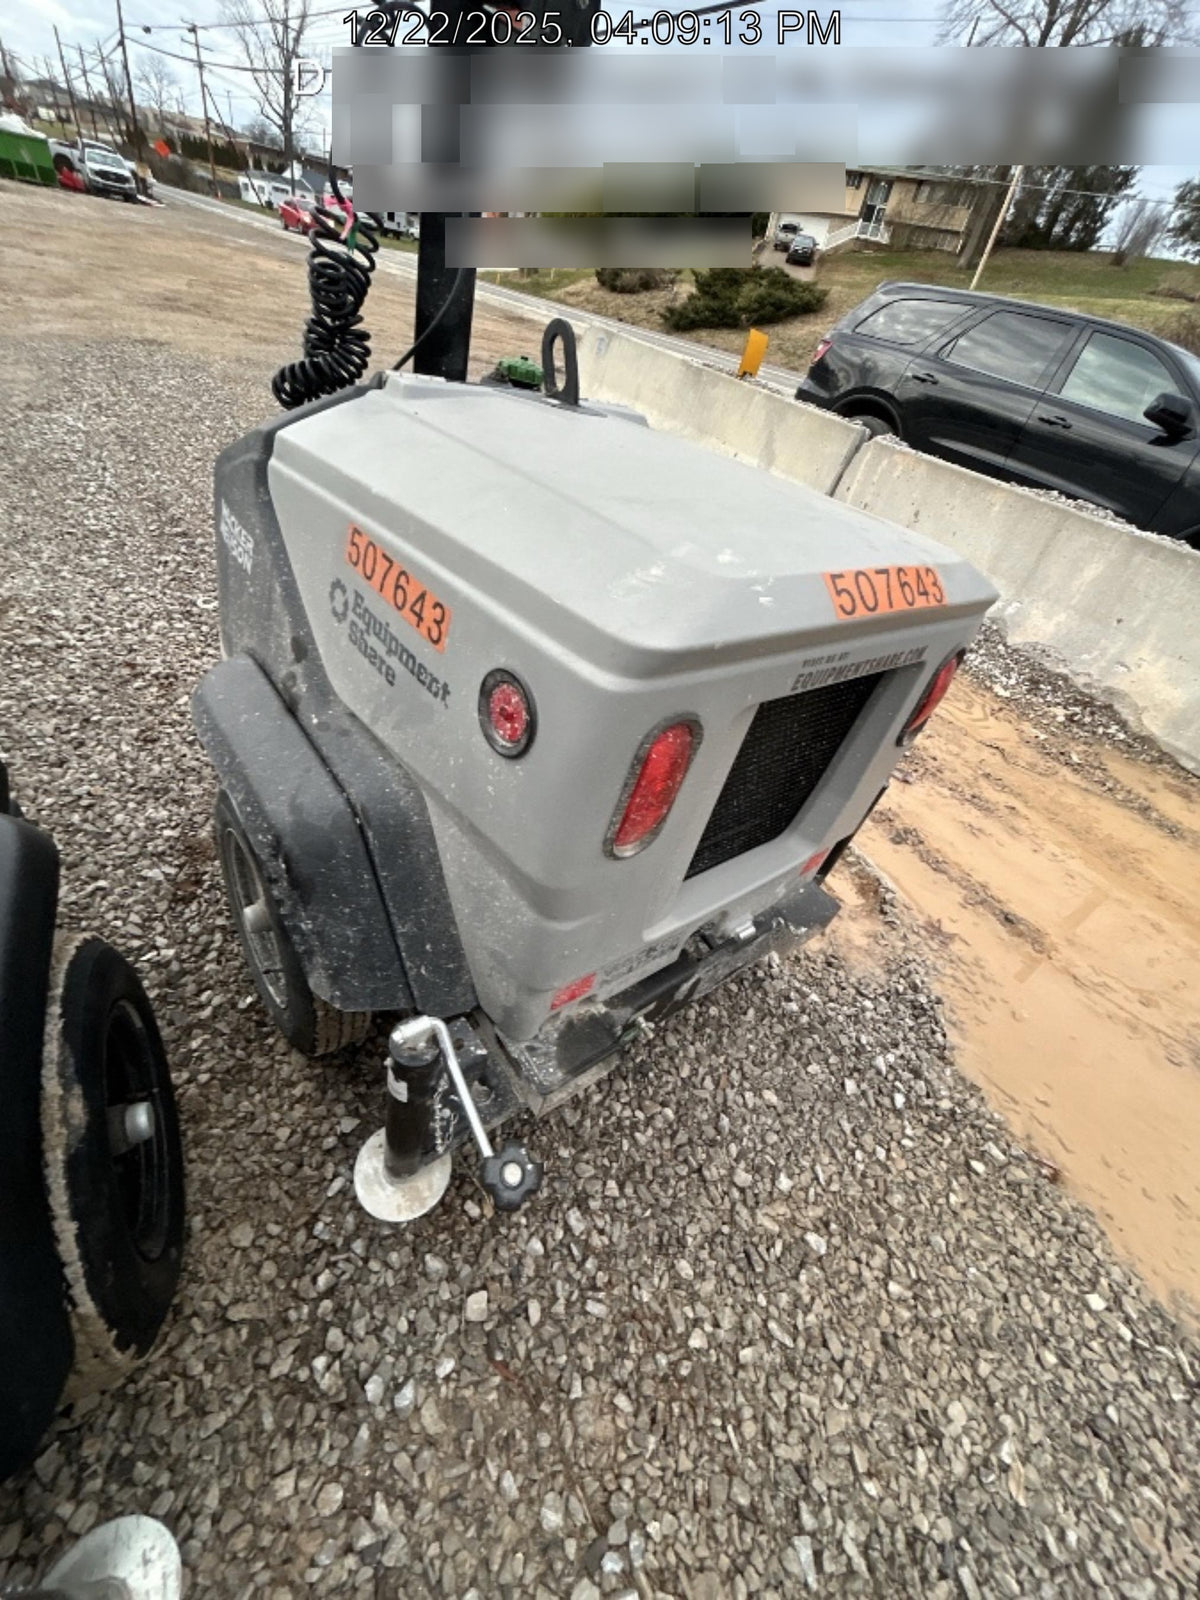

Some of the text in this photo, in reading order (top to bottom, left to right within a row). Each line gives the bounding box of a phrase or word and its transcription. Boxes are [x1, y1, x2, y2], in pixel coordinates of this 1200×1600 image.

[348, 526, 445, 646] 507643
[829, 566, 943, 616] 507643
[351, 589, 451, 707] Equipment
[791, 645, 928, 691] EQUIPMENTSHARE.COM
